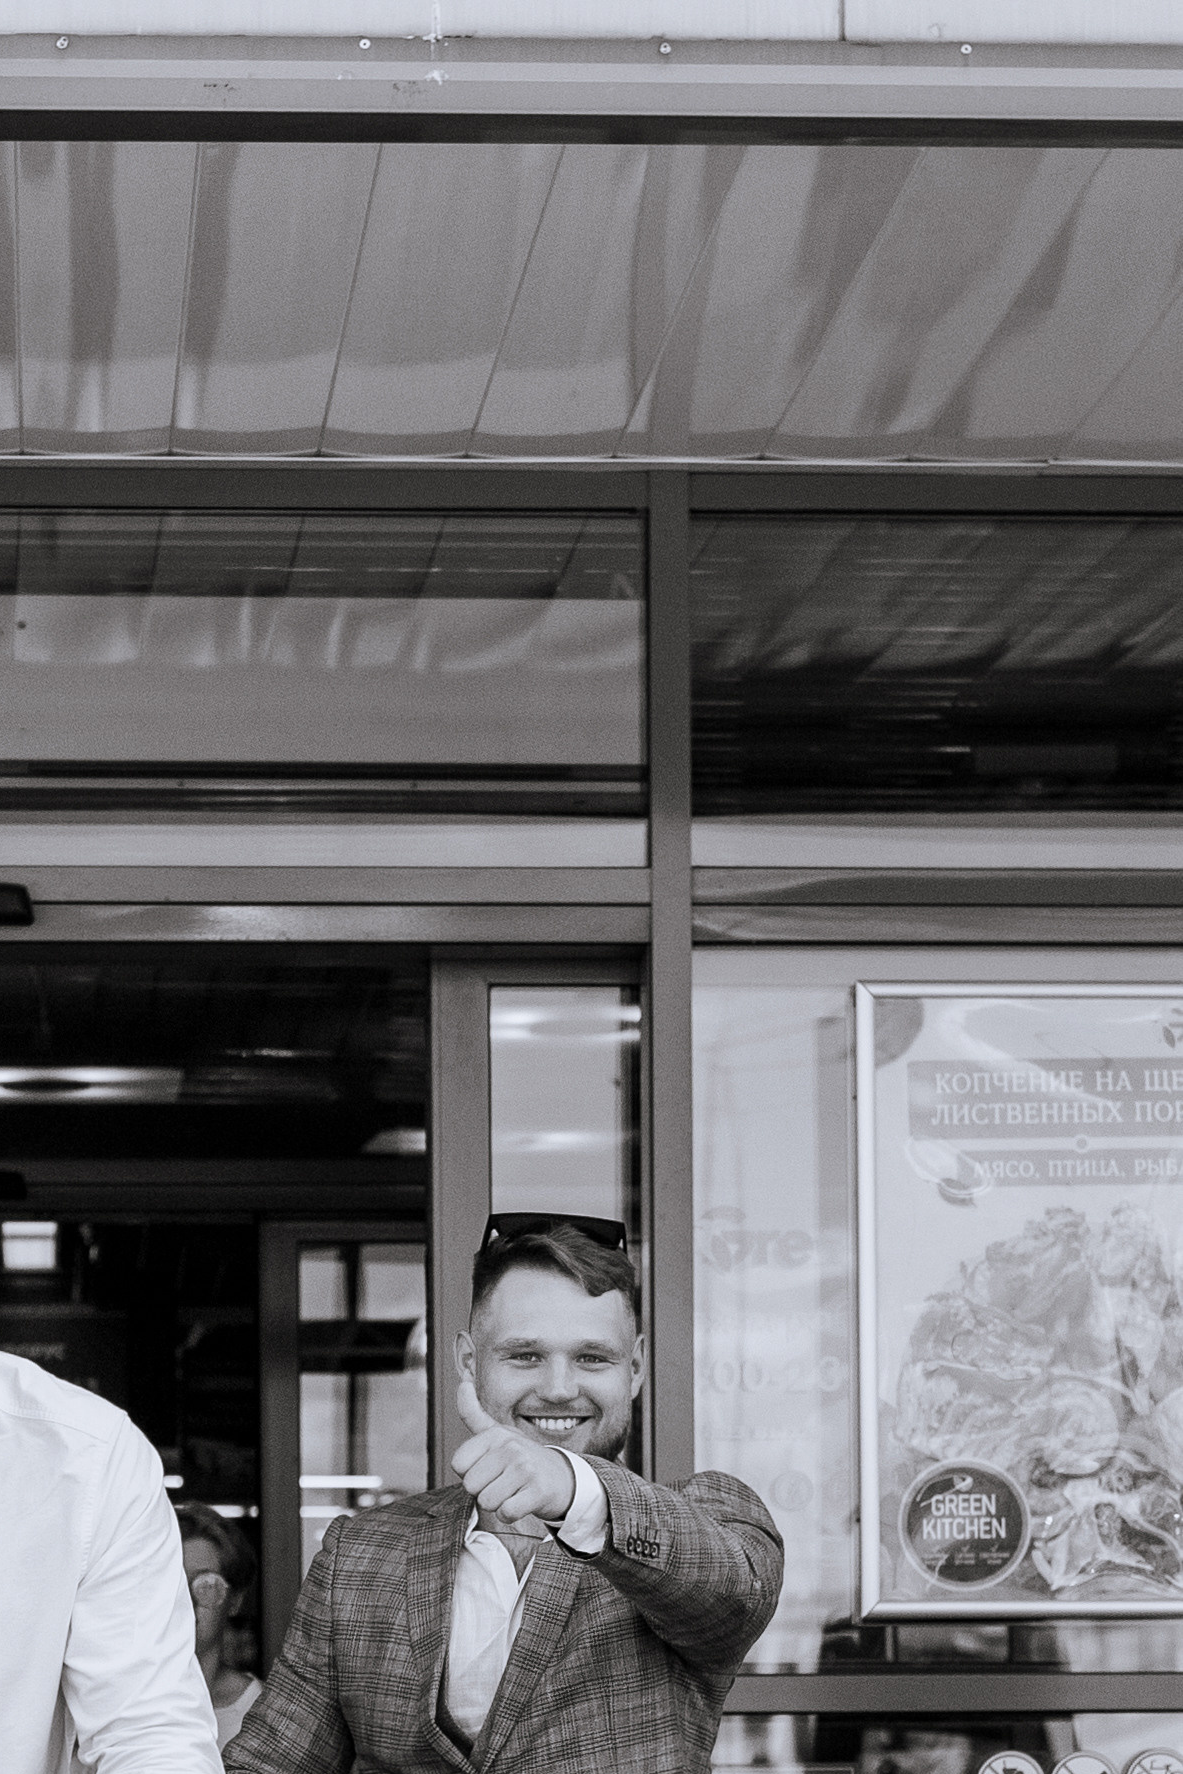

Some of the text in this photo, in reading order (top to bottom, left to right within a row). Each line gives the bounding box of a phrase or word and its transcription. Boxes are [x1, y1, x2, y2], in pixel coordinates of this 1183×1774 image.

[935, 1071, 1084, 1093] КОПЧЕНИЕ
[1096, 1070, 1132, 1091] НА
[931, 1101, 1122, 1125] ЛИСТВЕННЫХ
[931, 1494, 996, 1517] GREEN
[922, 1517, 1007, 1540] KITCHEN
